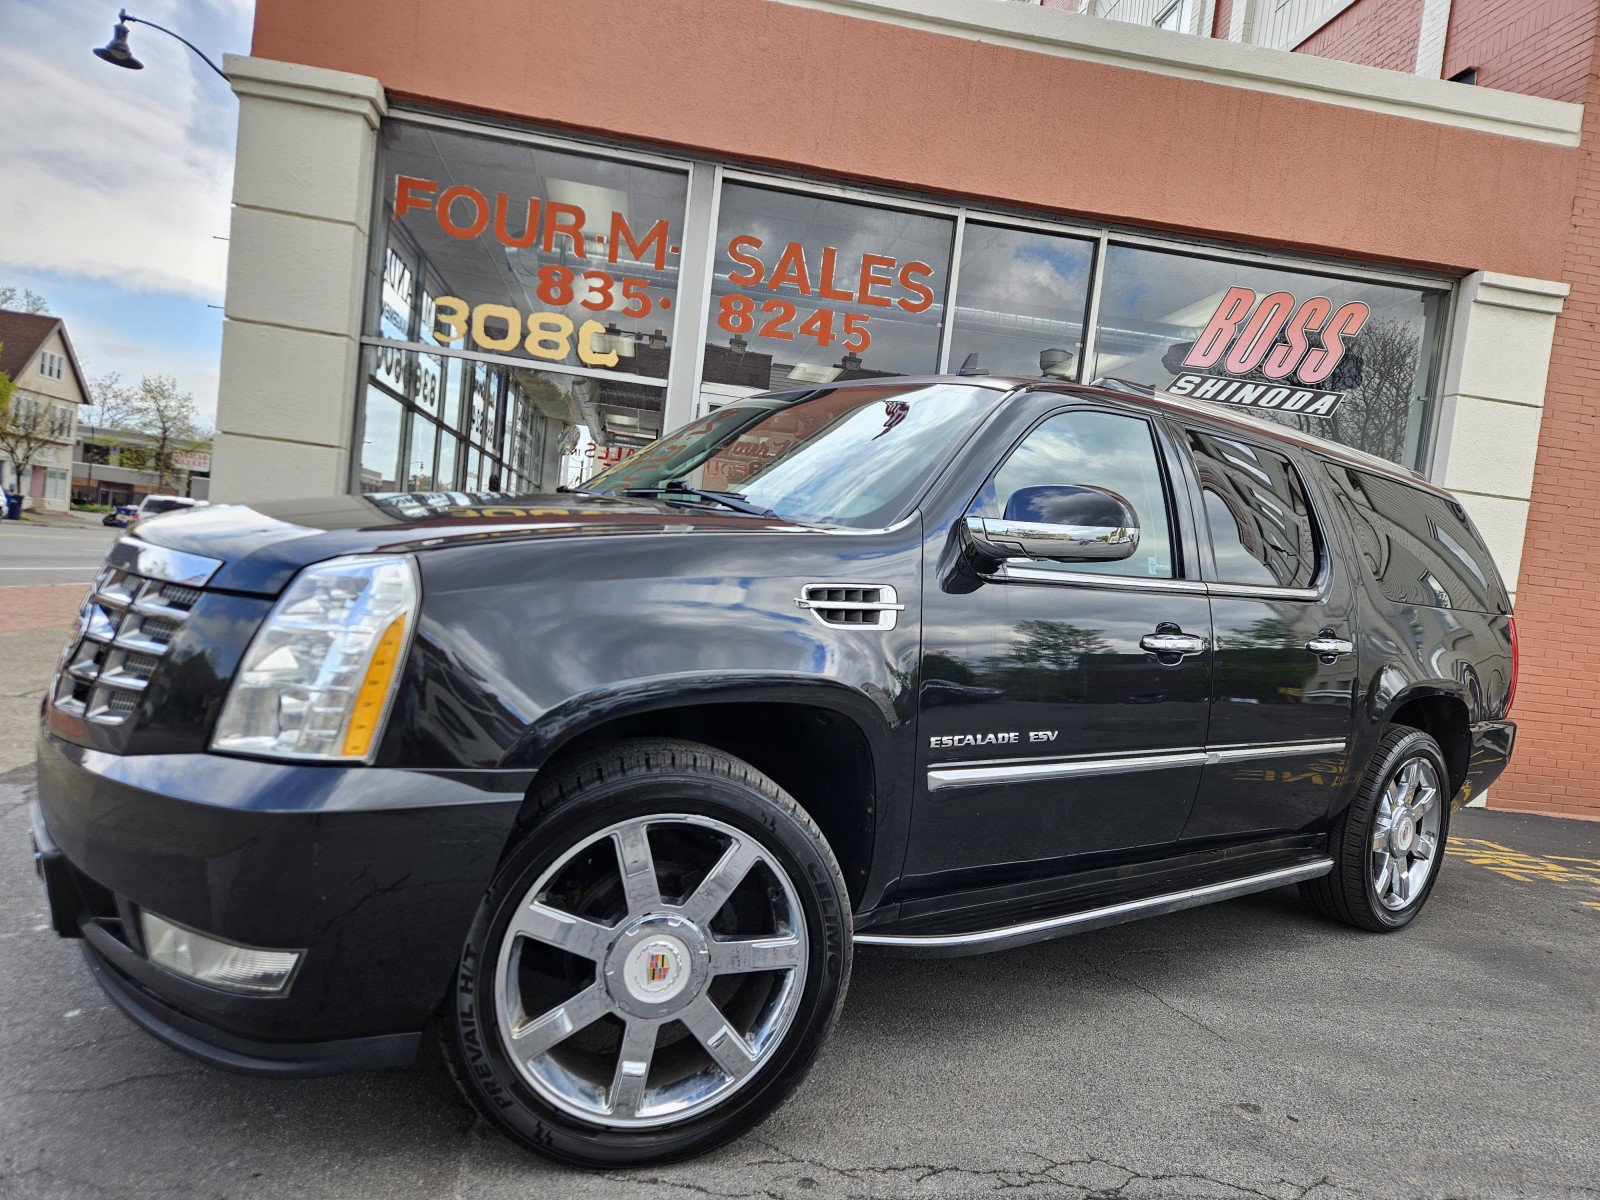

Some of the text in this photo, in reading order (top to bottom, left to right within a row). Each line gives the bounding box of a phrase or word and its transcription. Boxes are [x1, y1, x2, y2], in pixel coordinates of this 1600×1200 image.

[727, 234, 934, 314] SALES
[717, 293, 872, 354] 8245
[1181, 285, 1371, 384] BOSS
[1168, 375, 1338, 415] SHINODA
[929, 730, 1059, 749] ESCALADE ESV
[458, 943, 515, 1111] PREVAIL H/T
